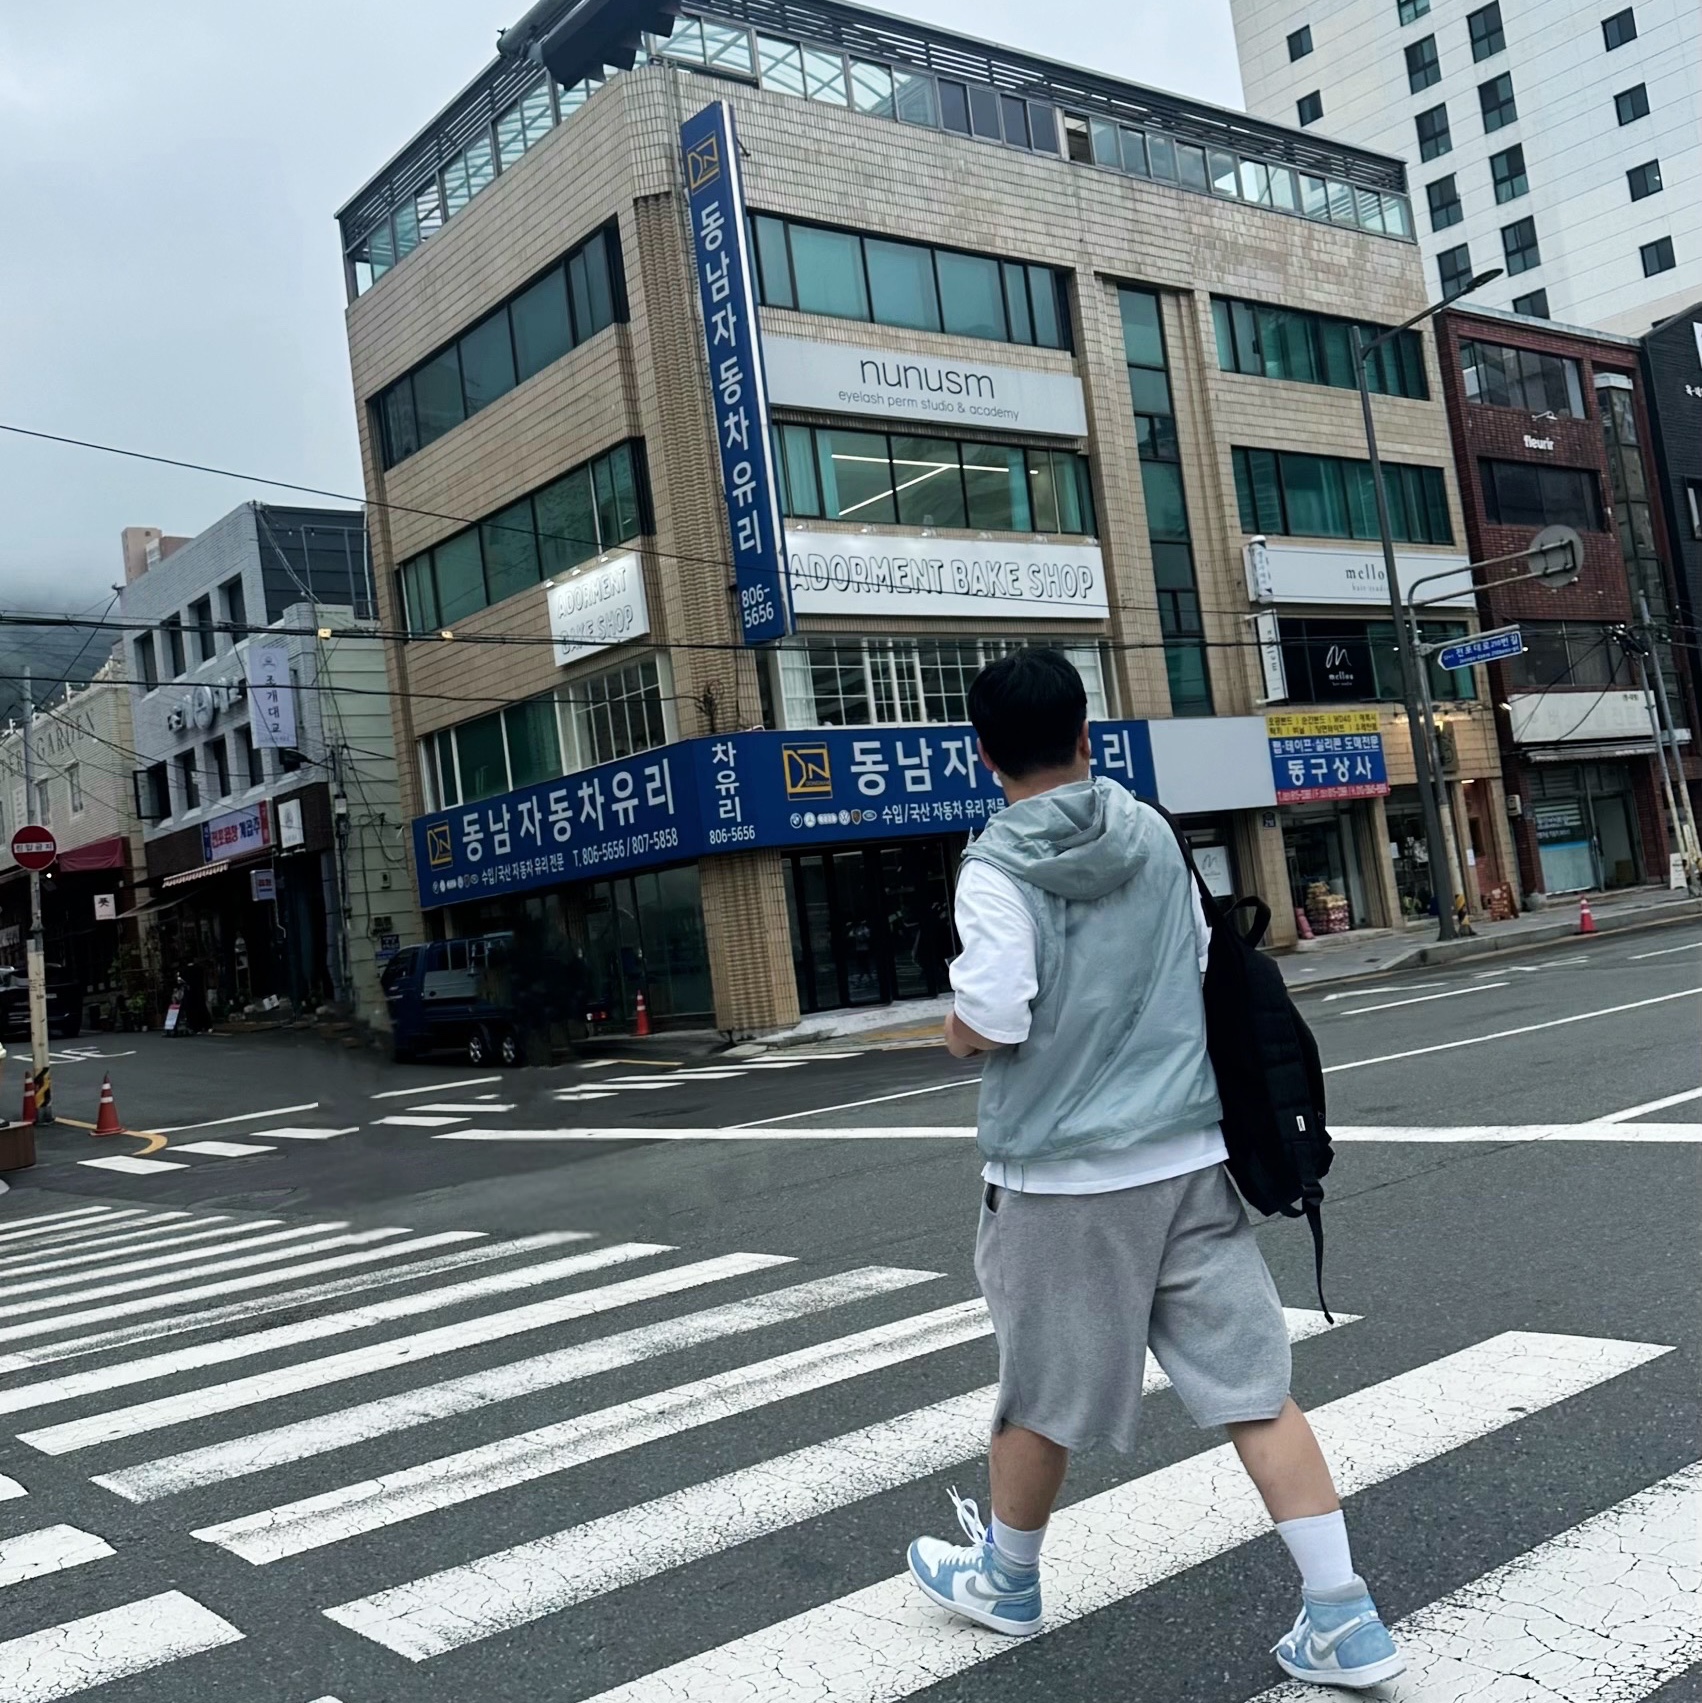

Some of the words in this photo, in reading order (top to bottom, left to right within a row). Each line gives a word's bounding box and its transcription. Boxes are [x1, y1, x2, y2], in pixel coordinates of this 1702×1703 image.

[700, 201, 763, 555] 동남자동차유리
[860, 359, 995, 400] nunusm
[838, 388, 885, 405] eyelash
[887, 396, 918, 408] perm
[921, 399, 954, 413] studio
[957, 402, 966, 414] &
[969, 403, 1019, 422] academy
[790, 553, 944, 595] ADORMENT
[951, 559, 1023, 597] BAKE
[1028, 563, 1094, 598] SHOP
[1345, 563, 1386, 581] mello
[557, 566, 626, 619] ADORMENT
[741, 583, 770, 608] 806-
[596, 604, 634, 641] SHOP
[744, 601, 775, 629] 5656
[850, 729, 1134, 797] 동남자리
[1287, 755, 1373, 786] 동구상사
[711, 741, 742, 823] 차유리
[462, 758, 675, 862] 동남자동차유리
[882, 803, 931, 826] 수입/국산
[932, 800, 963, 822] 자동차
[965, 798, 985, 819] 유리
[632, 827, 679, 854] 807-5858
[709, 824, 756, 845] 806-5656
[481, 861, 511, 886] 수입/국산
[511, 859, 533, 880] 자동차
[534, 856, 549, 876] 유리
[549, 853, 565, 872] 전문
